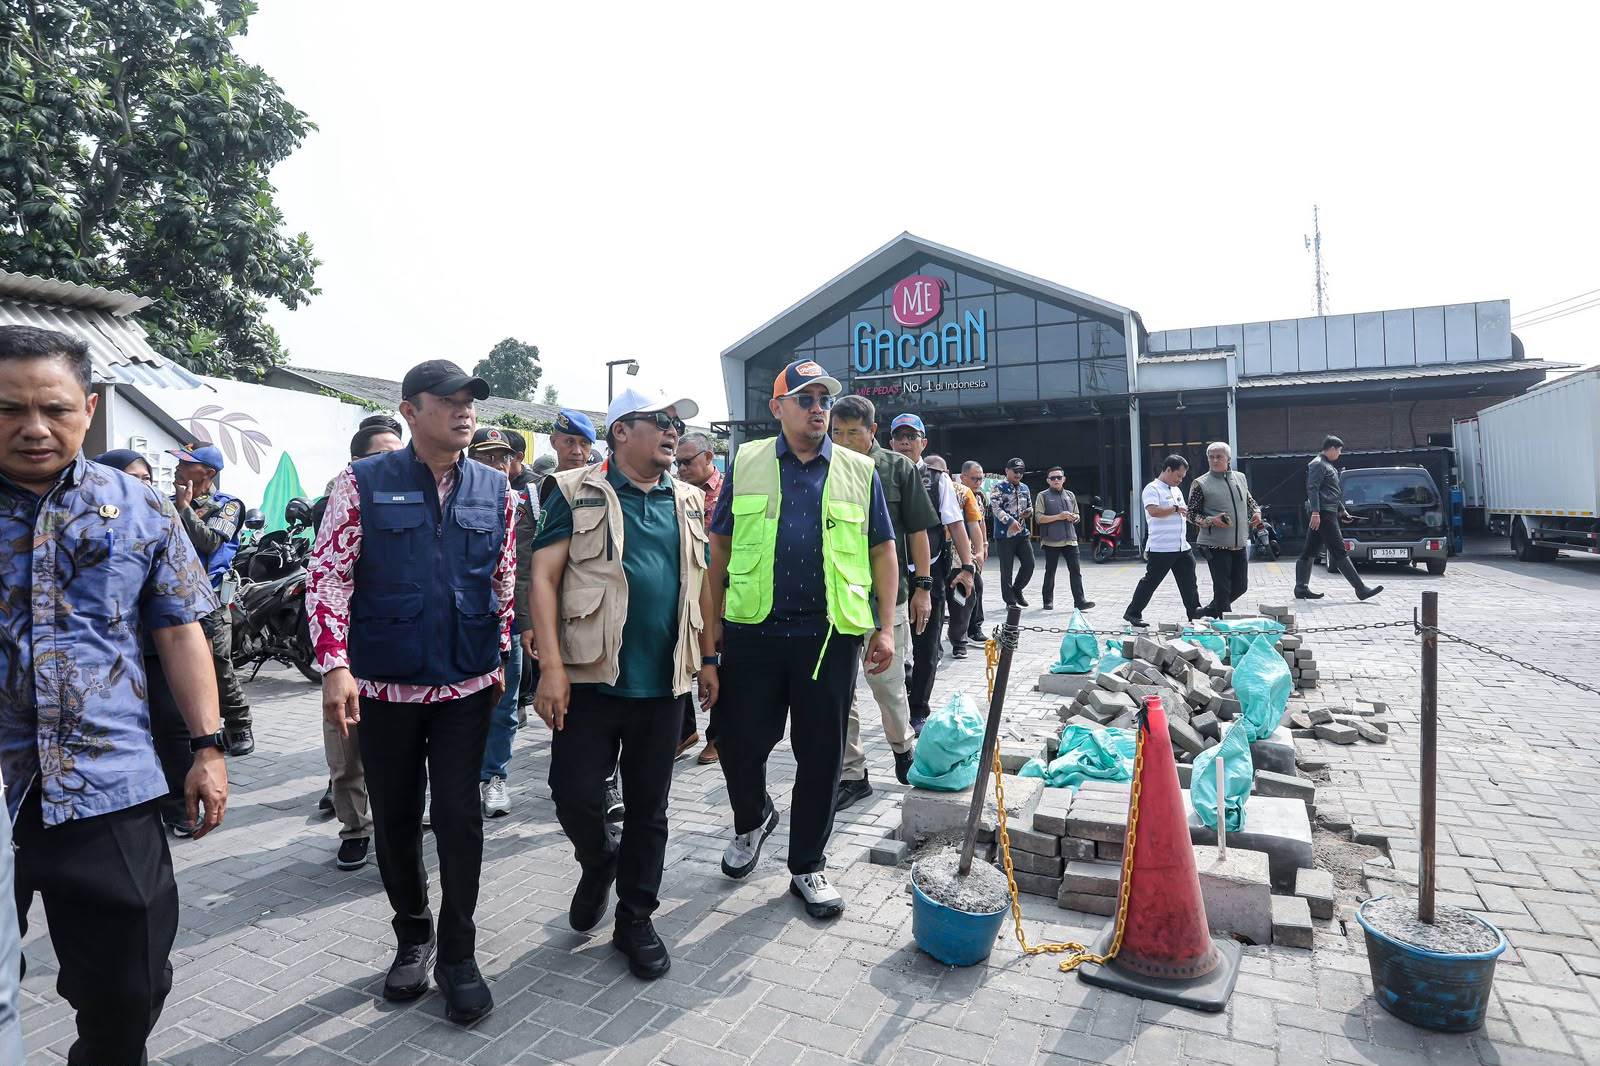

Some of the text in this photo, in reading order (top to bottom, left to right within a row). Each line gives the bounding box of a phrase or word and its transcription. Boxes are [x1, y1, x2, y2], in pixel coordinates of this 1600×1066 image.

[854, 308, 986, 372] GACOAN
[856, 387, 871, 396] MIE
[872, 384, 900, 395] PEDAS
[926, 380, 933, 391] 1
[936, 381, 944, 390] di
[946, 379, 986, 390] Indonesia
